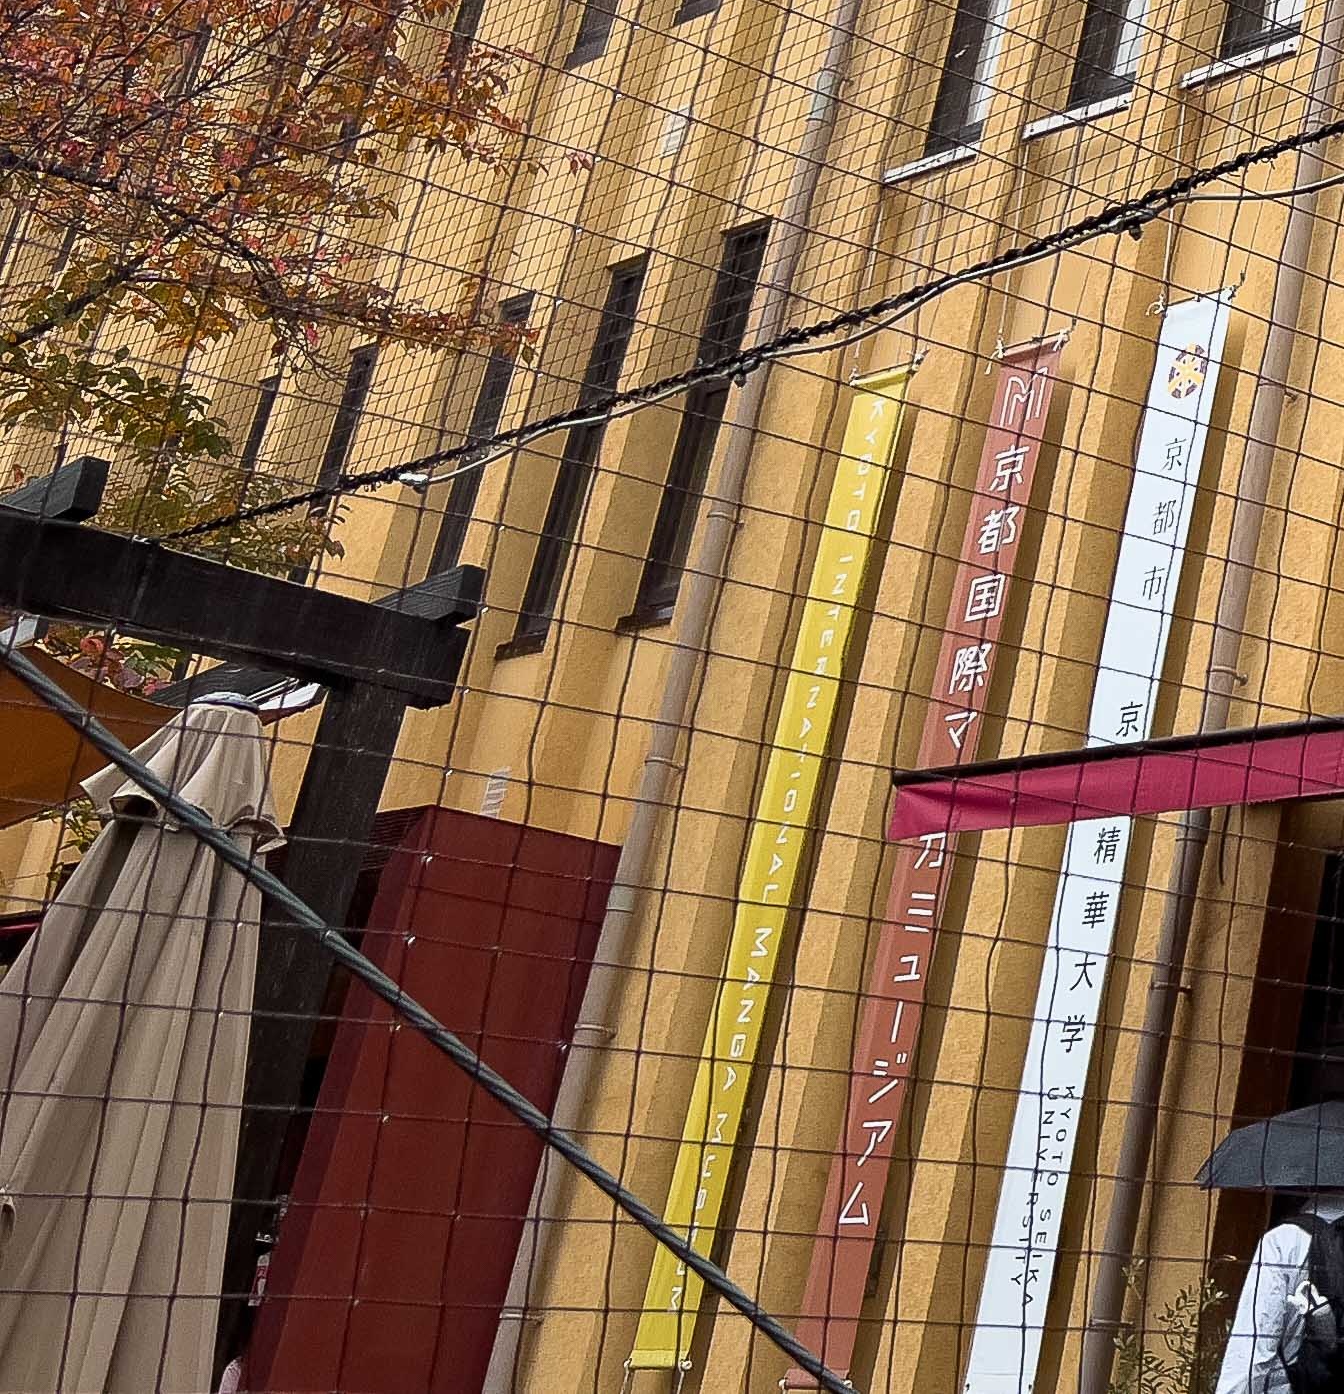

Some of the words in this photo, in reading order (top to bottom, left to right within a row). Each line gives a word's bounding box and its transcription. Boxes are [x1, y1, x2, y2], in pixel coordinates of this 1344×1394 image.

[1142, 436, 1188, 602] 京都市
[1046, 1085, 1076, 1187] KYOTO
[1024, 1207, 1053, 1306] SEIKA
